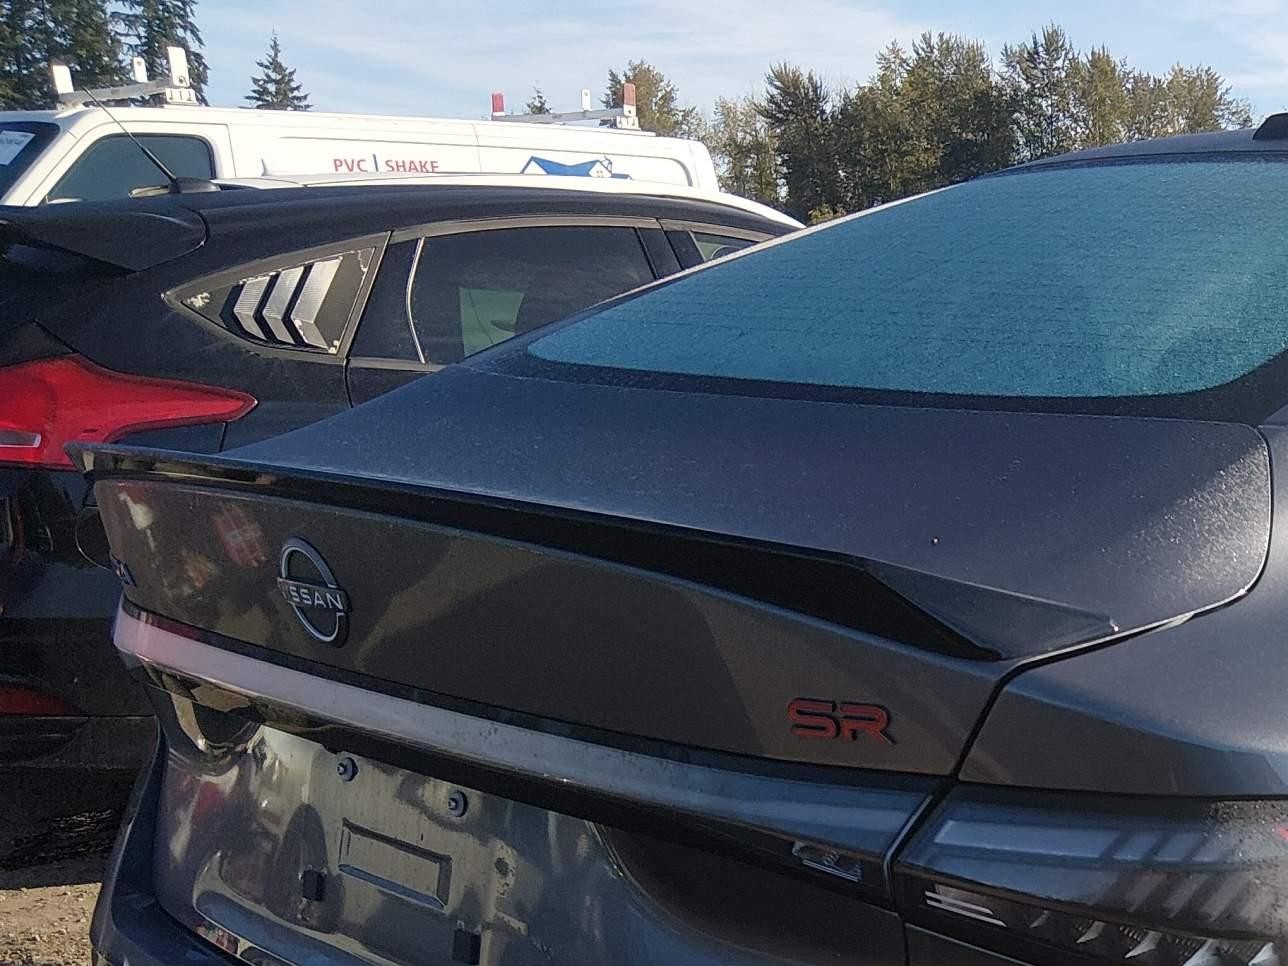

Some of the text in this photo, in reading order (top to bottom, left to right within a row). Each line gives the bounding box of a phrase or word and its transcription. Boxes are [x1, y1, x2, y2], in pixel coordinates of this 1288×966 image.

[332, 158, 440, 174] PVC SHAKE
[787, 698, 896, 745] SR
